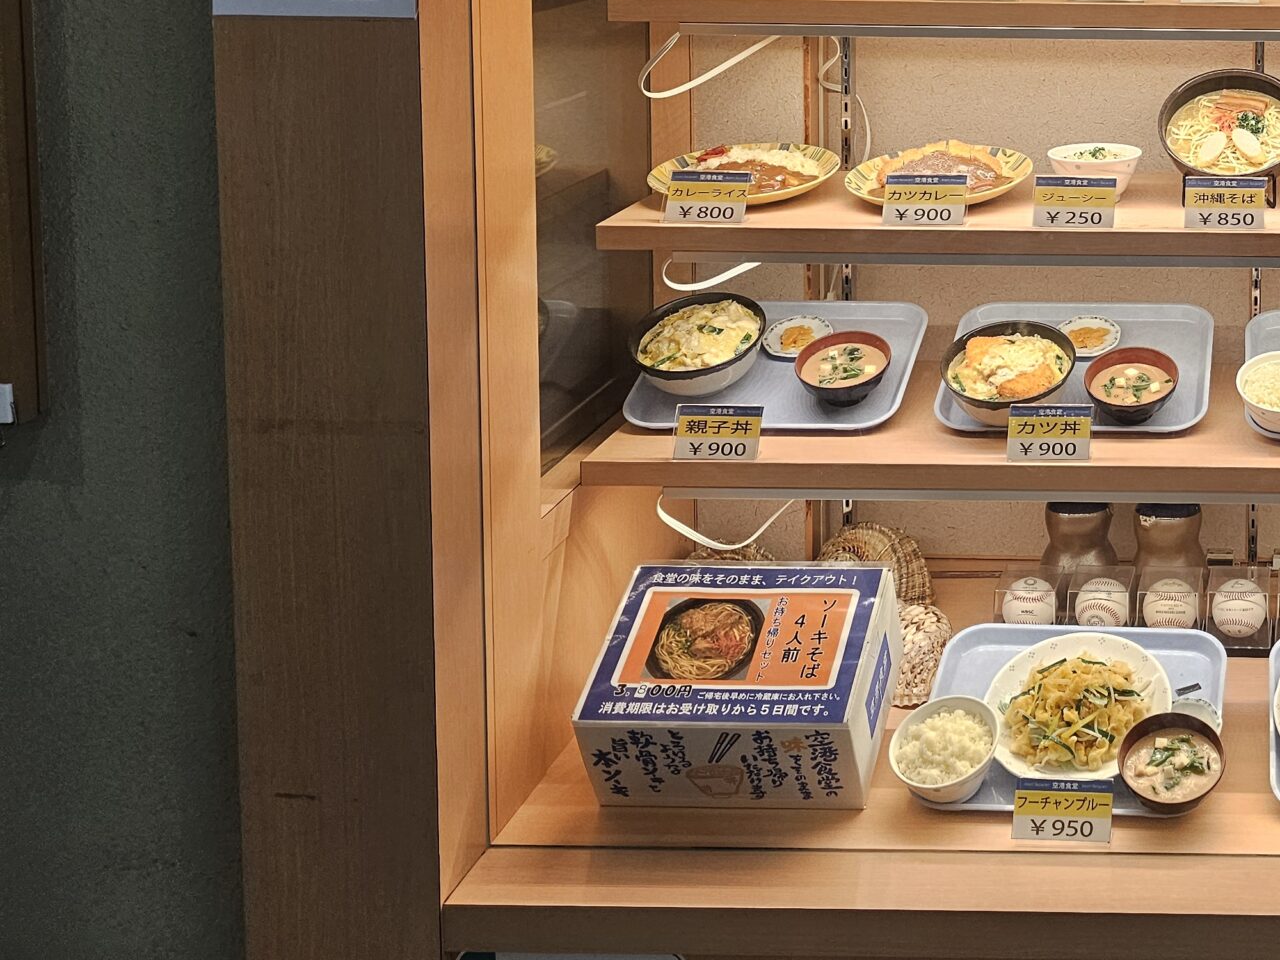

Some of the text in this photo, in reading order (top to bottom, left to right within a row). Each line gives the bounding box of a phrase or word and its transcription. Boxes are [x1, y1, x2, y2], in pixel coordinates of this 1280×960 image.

[671, 188, 748, 198] カレーライス
[887, 190, 964, 201] カツカレー
[1042, 192, 1106, 203] ジューシー
[1194, 192, 1258, 205] 沖縄そば
[684, 420, 753, 435] 親子丼
[1017, 420, 1081, 436] カツ丼
[755, 596, 789, 682] お持ち帰りセット
[780, 614, 807, 663] 4人前
[799, 598, 838, 679] ソーキそば
[599, 702, 831, 716] 消費期限はお受け取りから5日間です。
[1017, 795, 1110, 812] フーチャンプルー
